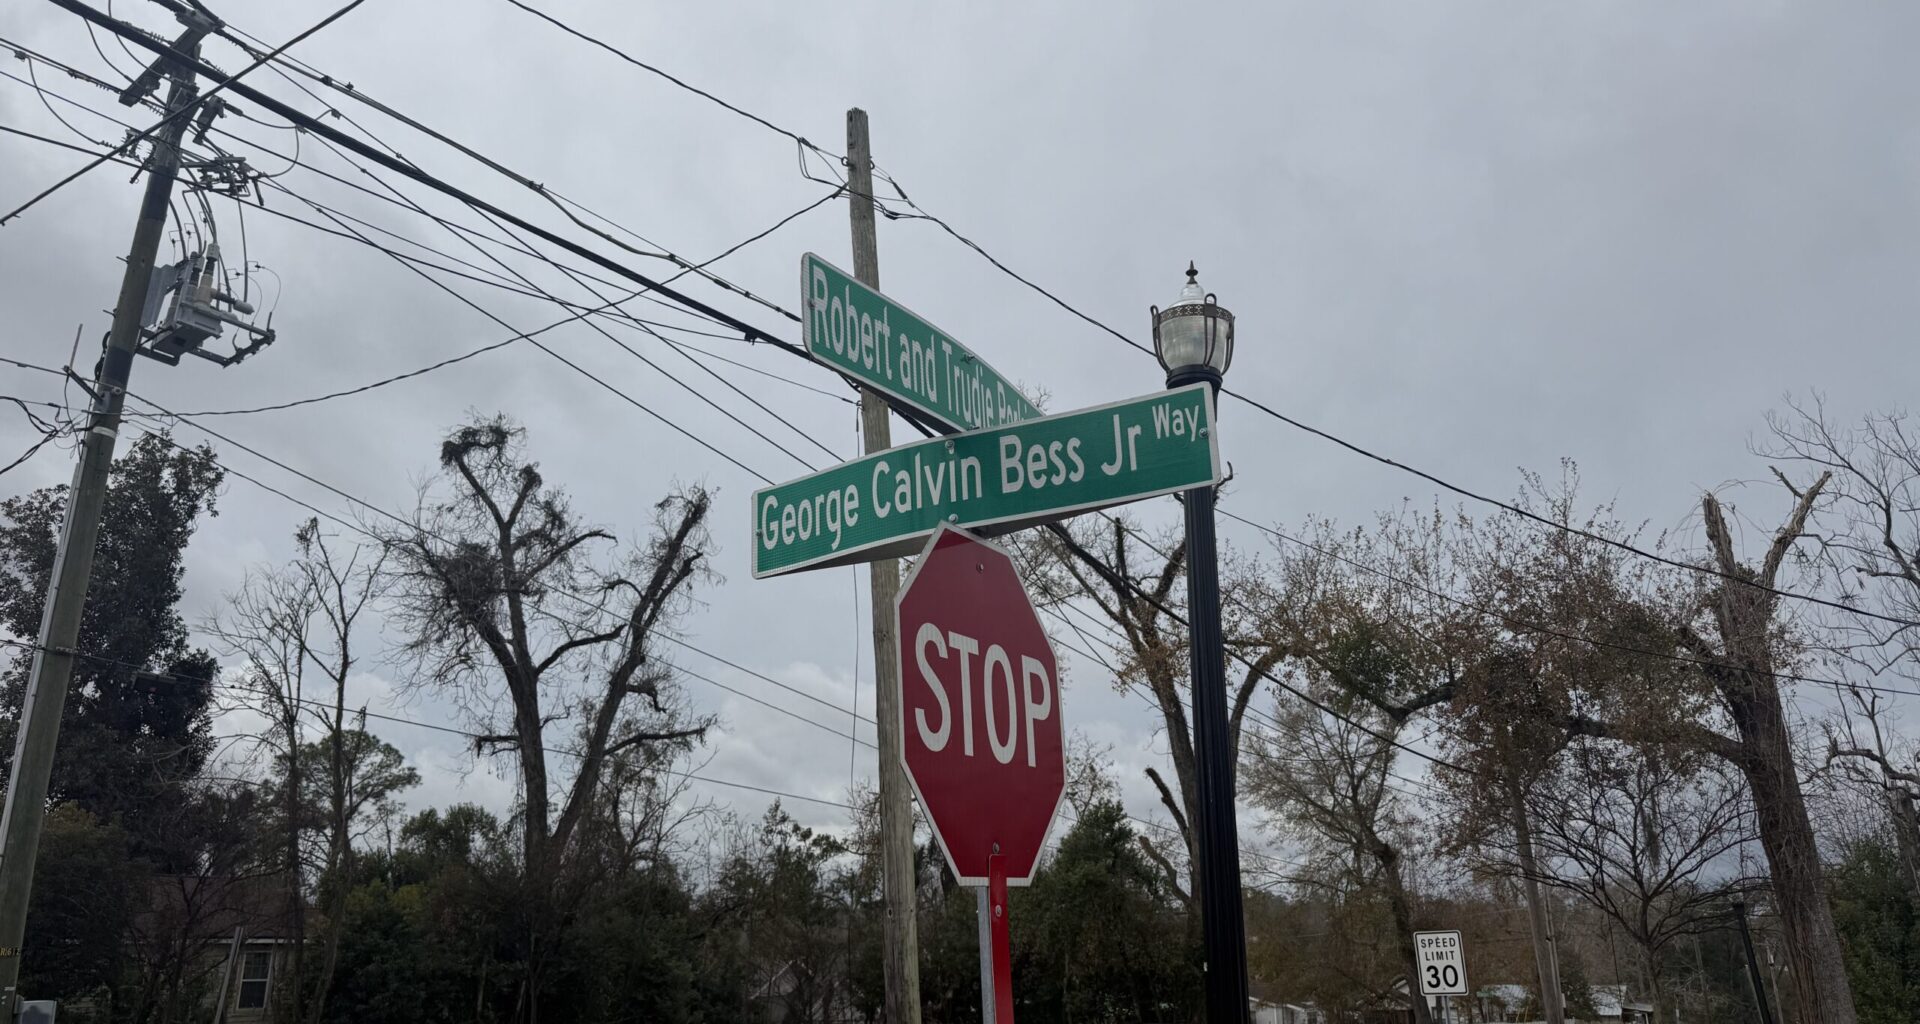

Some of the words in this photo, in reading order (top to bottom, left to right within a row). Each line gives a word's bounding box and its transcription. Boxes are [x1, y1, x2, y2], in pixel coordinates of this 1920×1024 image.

[813, 264, 892, 380] Robert
[900, 334, 937, 403] and
[942, 340, 994, 428] Trudie
[762, 484, 859, 551] George
[872, 447, 983, 519] Calvin
[1000, 434, 1085, 494] Bess
[1101, 414, 1142, 476] Jr
[1152, 403, 1200, 442] Way
[914, 622, 1051, 768] STOP
[1420, 936, 1456, 949] SPEED
[1425, 950, 1455, 961] LIMIT
[1426, 964, 1459, 989] 30
